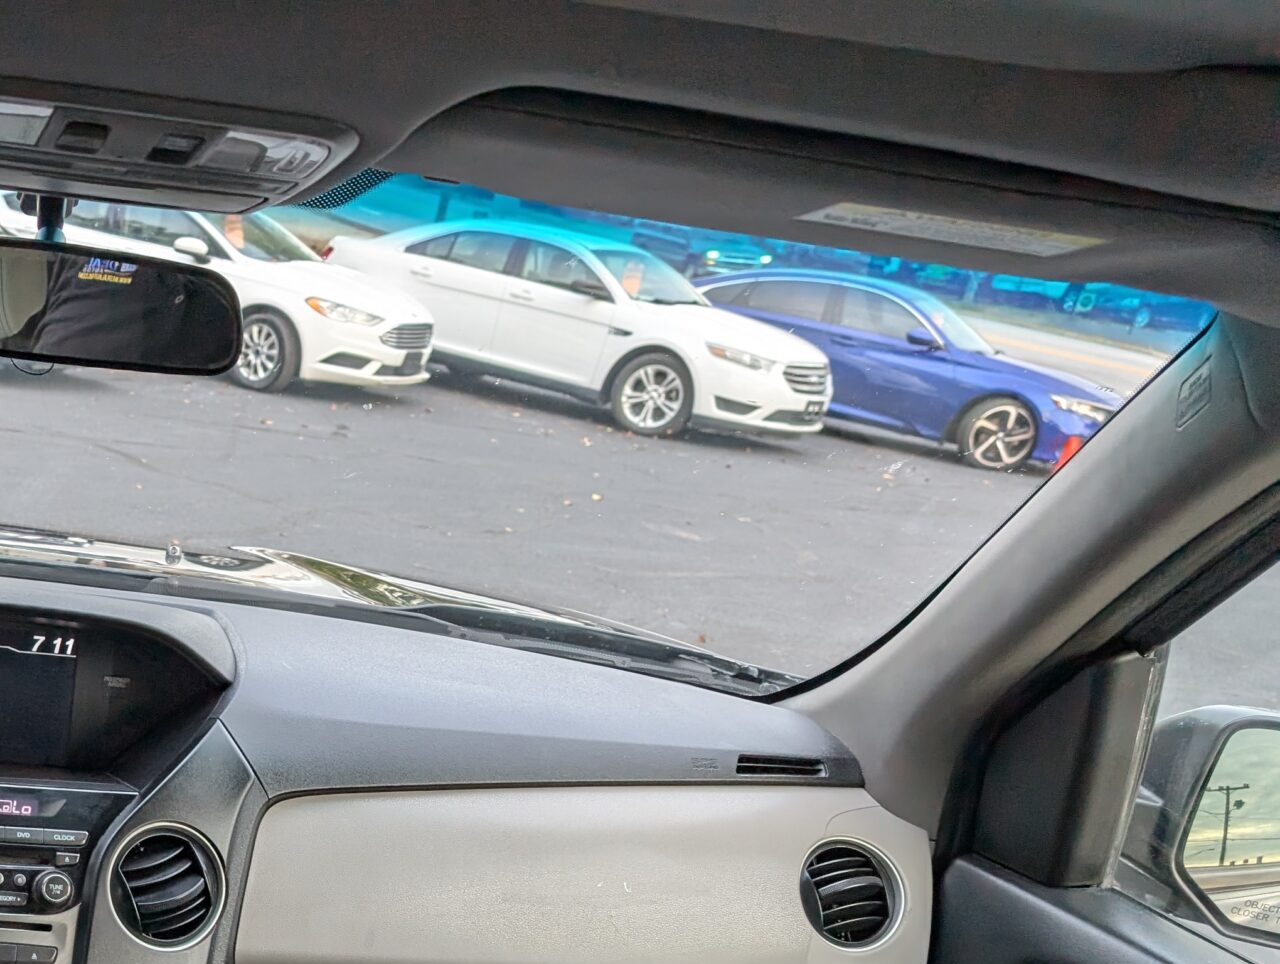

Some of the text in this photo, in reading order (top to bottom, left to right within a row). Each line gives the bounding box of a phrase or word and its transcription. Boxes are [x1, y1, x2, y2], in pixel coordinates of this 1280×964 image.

[32, 635, 75, 655] 7 11
[1230, 906, 1270, 921] CLOSER
